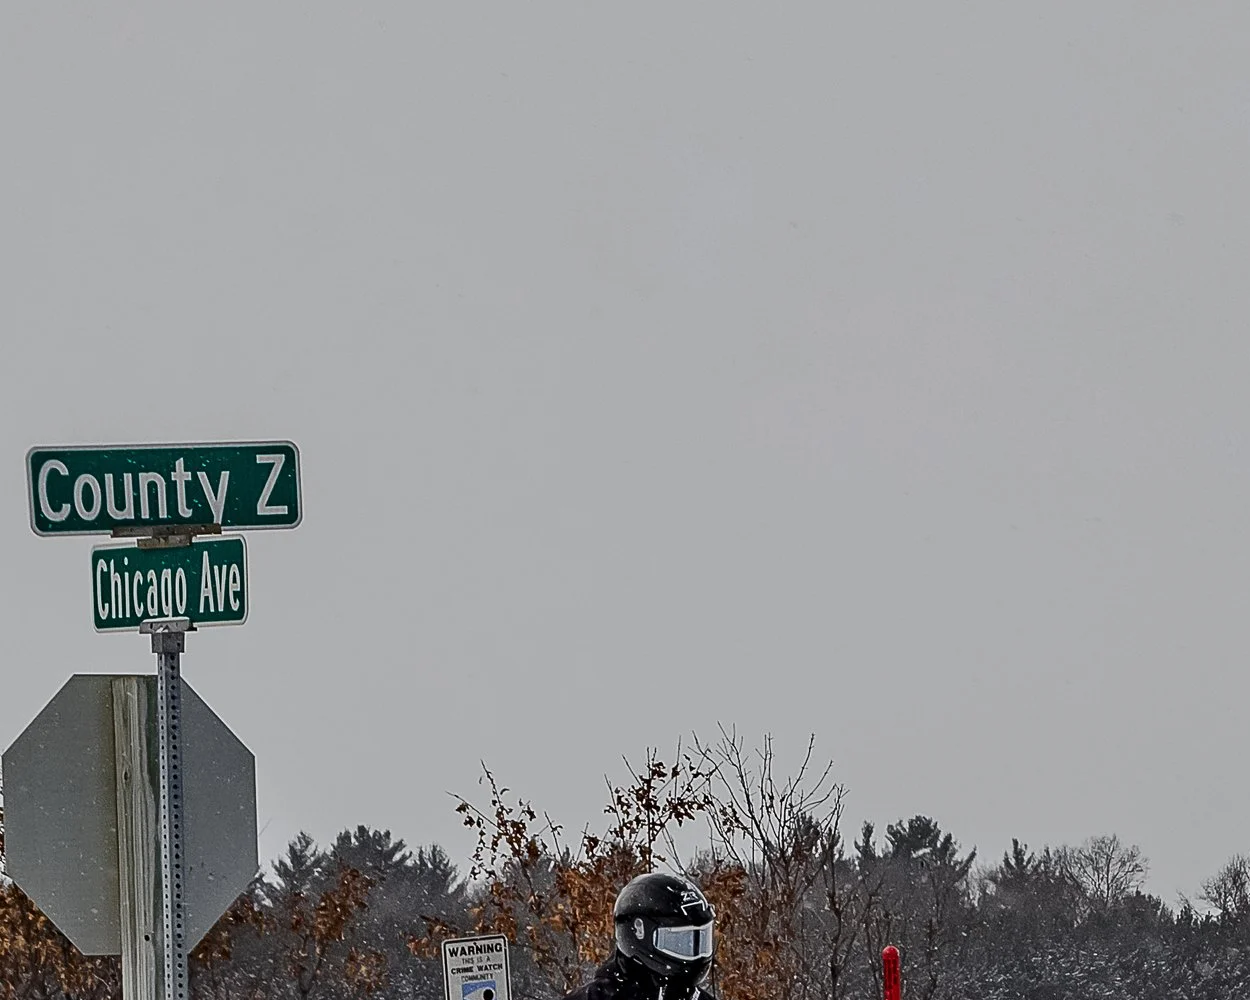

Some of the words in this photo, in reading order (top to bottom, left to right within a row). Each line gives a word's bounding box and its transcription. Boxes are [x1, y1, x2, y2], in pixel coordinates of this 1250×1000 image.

[38, 457, 230, 524] County
[256, 453, 289, 516] Z
[96, 556, 187, 619] Chicago
[199, 550, 241, 613] Ave
[448, 943, 503, 958] WARNING
[462, 957, 474, 965] THIS
[450, 966, 474, 975] CRIME
[477, 963, 503, 972] WATCH
